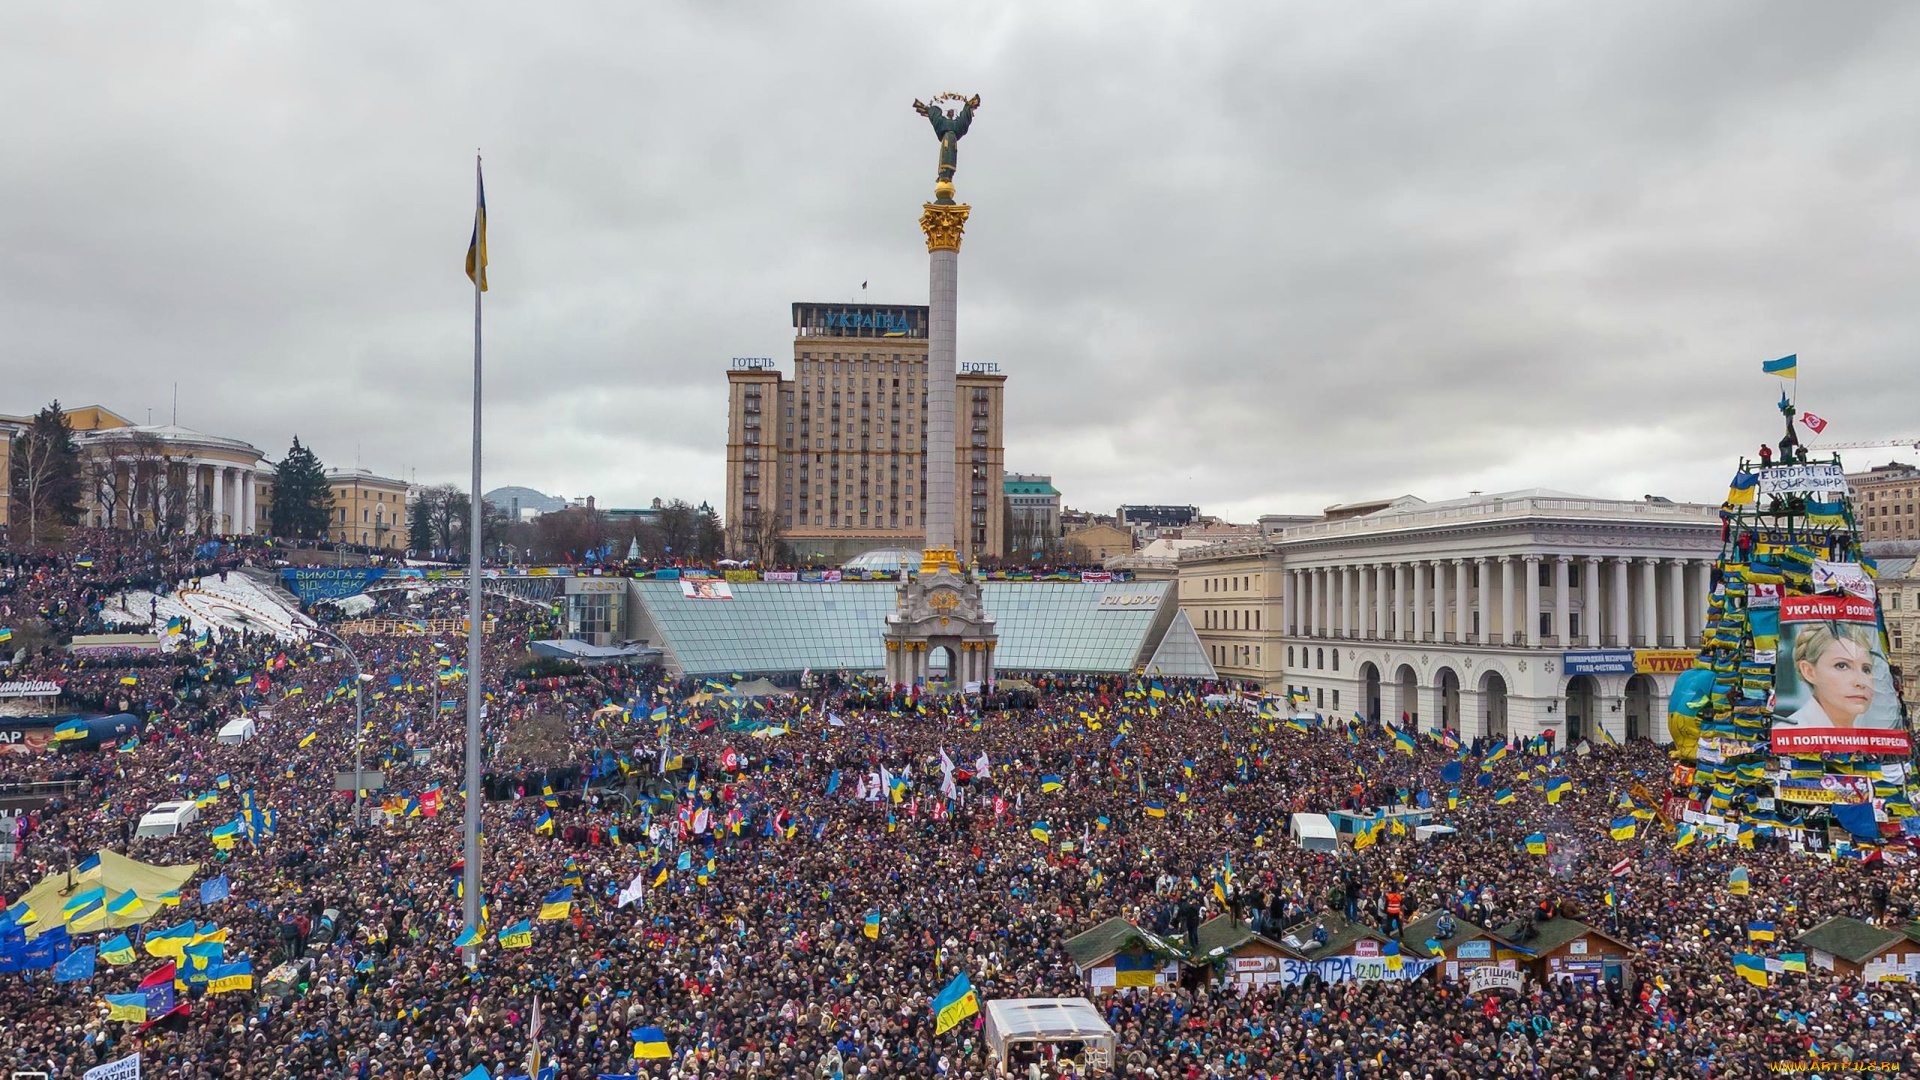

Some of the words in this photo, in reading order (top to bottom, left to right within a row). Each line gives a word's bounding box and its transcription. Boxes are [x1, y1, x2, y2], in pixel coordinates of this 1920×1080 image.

[826, 313, 909, 330] УКРАЇНА
[732, 357, 775, 367] ГОТЕЛЬ
[962, 362, 1001, 372] HOTEL
[1771, 480, 1807, 491] YOUR
[1786, 602, 1836, 615] УКРАЇНІ
[0, 680, 58, 697] ampions
[1777, 737, 1789, 745] НІ
[1793, 735, 1869, 745] ПОЛІТИЧНИМ
[1355, 963, 1381, 979] 12:00
